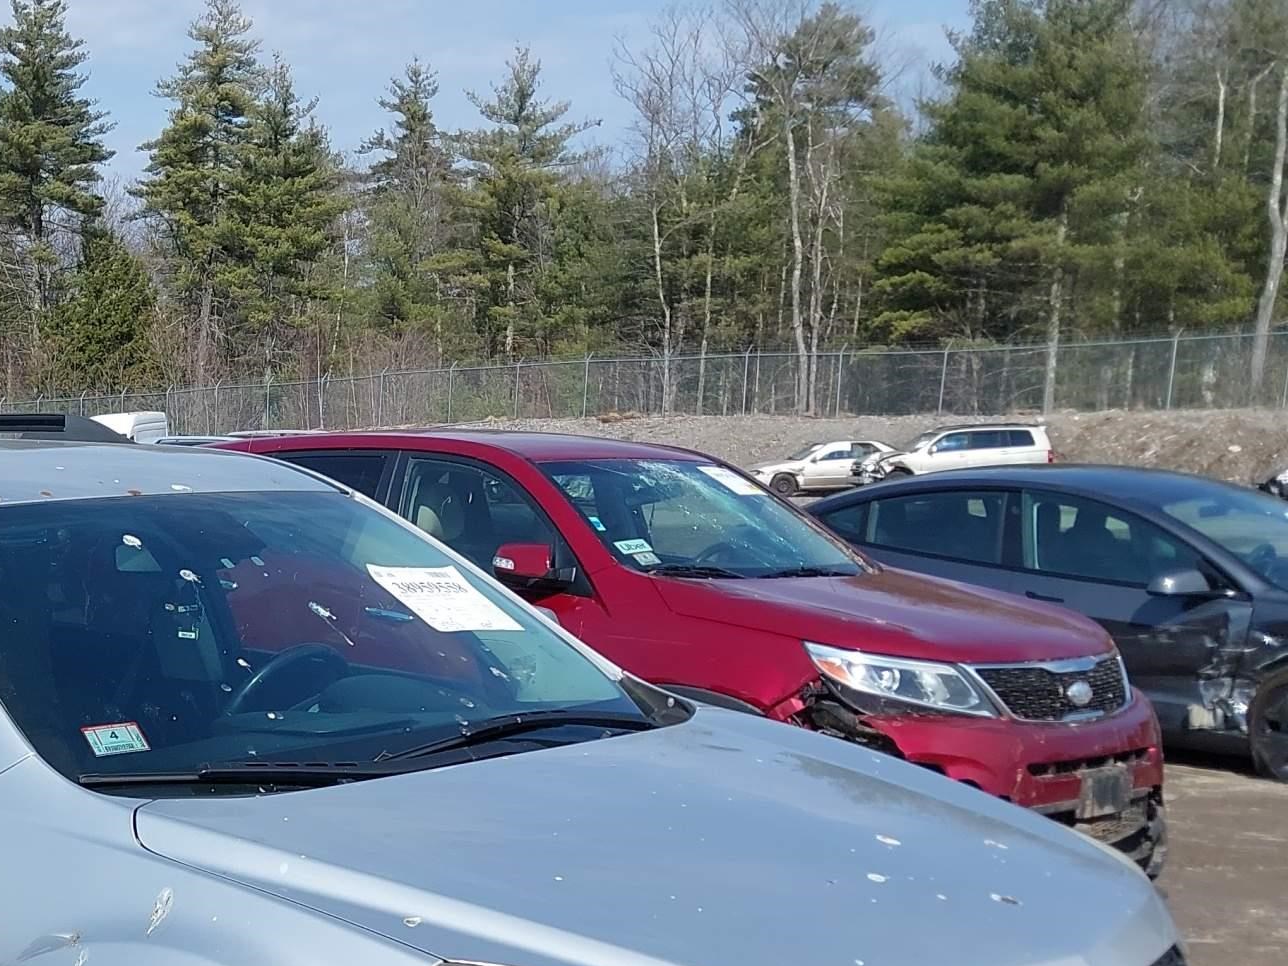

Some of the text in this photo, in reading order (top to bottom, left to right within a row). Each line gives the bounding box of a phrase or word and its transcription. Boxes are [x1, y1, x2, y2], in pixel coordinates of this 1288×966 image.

[619, 542, 647, 551] Uber
[392, 581, 468, 594] 38959558
[109, 731, 119, 740] 4
